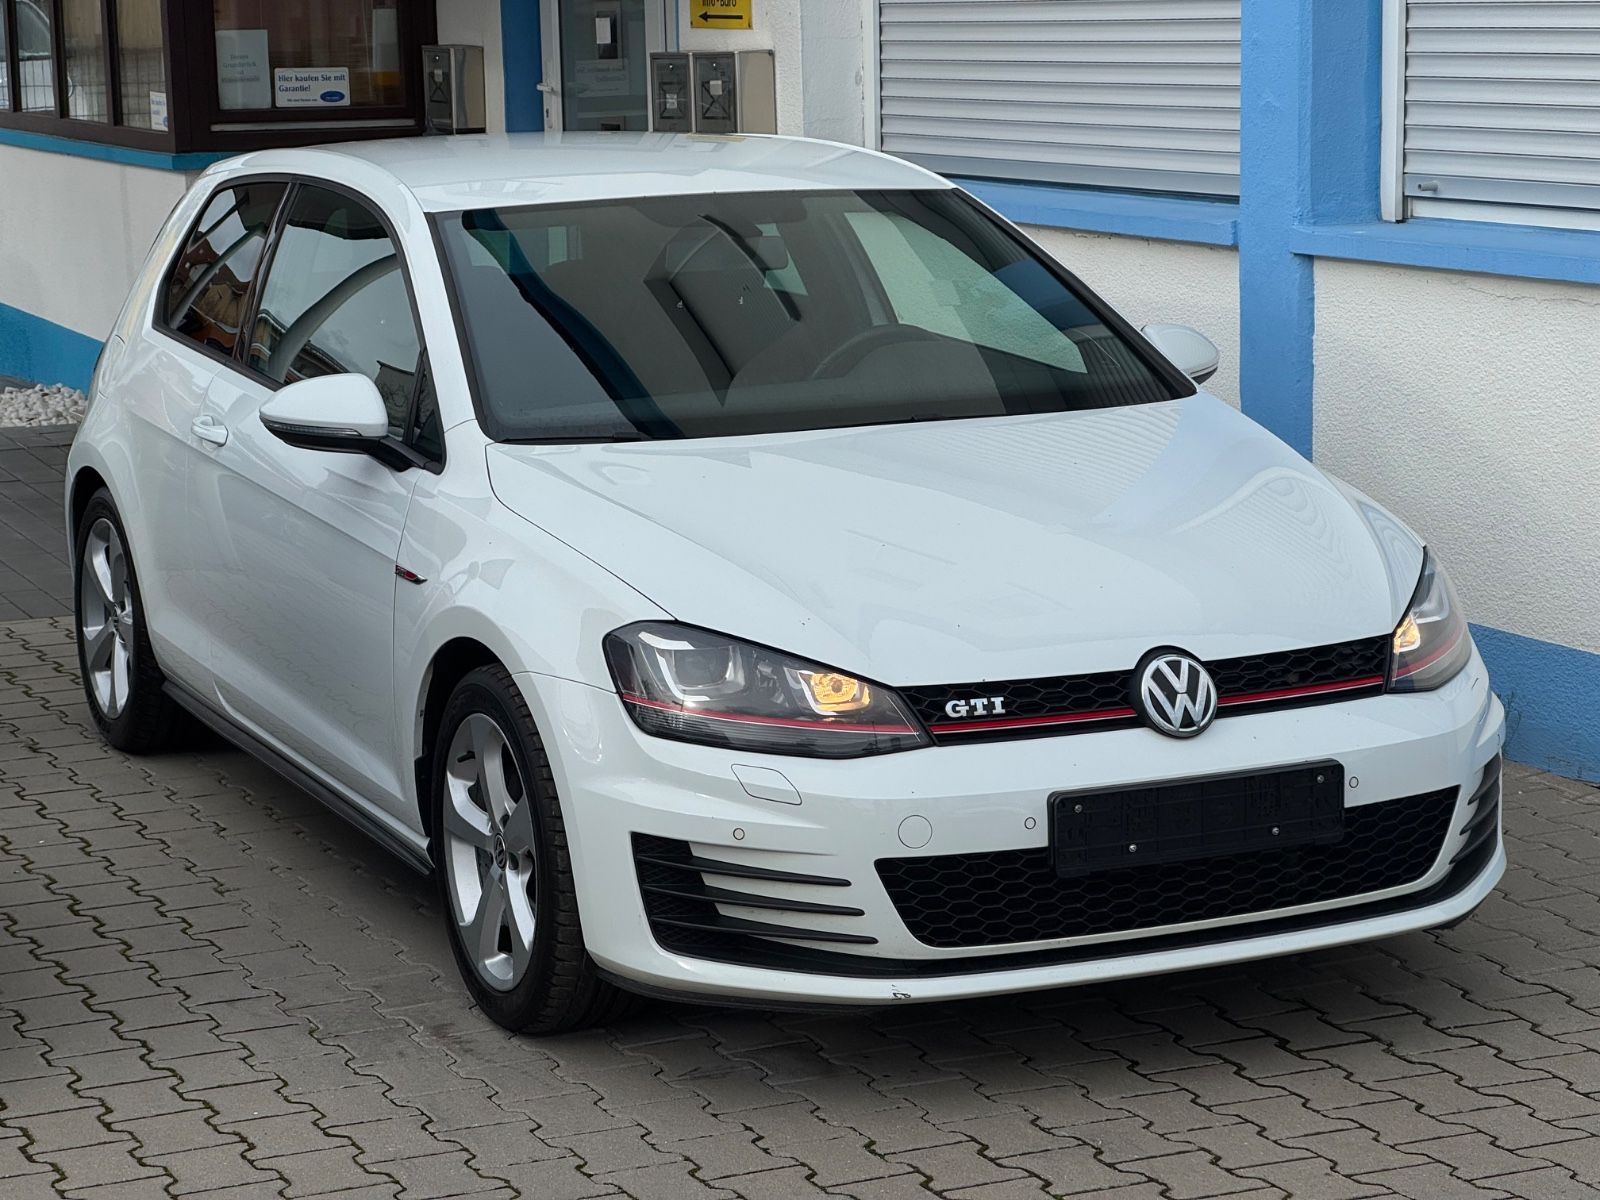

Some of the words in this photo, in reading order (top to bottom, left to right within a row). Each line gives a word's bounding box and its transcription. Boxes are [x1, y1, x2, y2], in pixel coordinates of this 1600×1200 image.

[278, 74, 293, 82] Hier
[295, 74, 319, 82] kaufen
[1143, 656, 1216, 735] VW
[945, 696, 1007, 719] GTI
